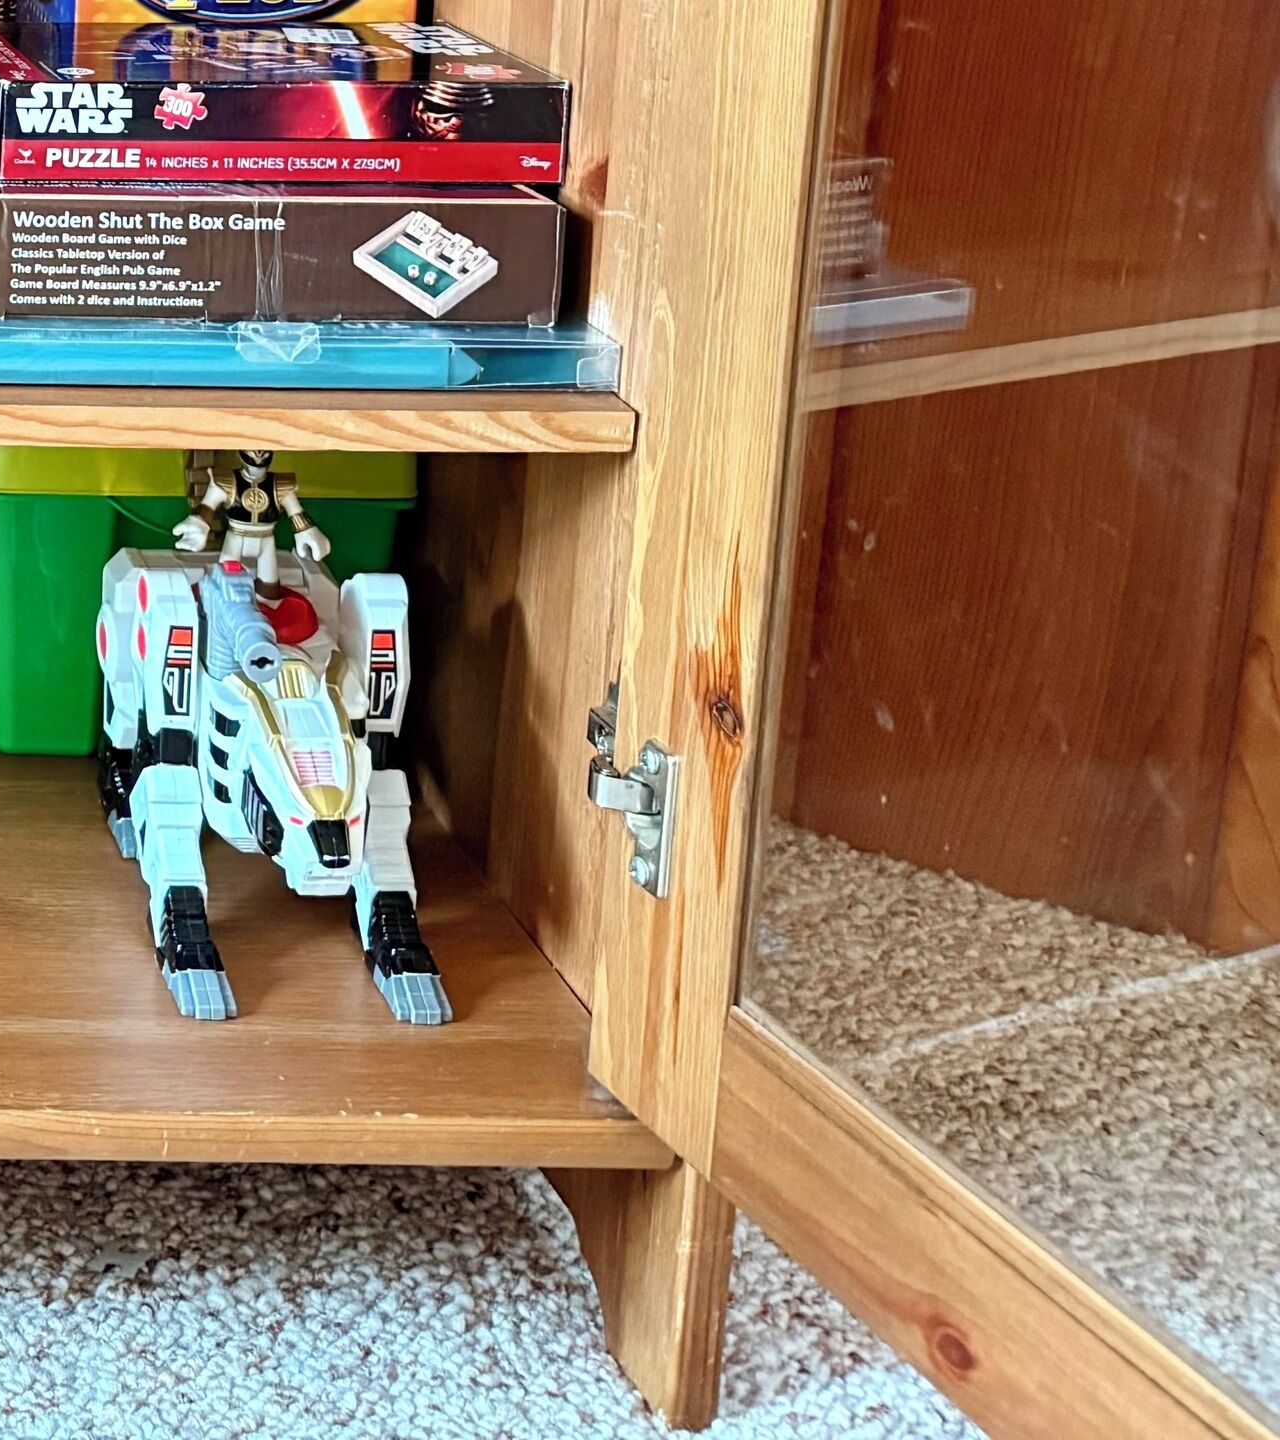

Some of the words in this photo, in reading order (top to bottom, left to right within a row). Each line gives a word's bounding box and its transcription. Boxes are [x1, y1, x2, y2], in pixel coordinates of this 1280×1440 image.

[15, 83, 133, 109] STAR
[164, 95, 193, 117] 300
[15, 108, 133, 134] WARS
[45, 147, 142, 168] PUZZLE
[145, 157, 158, 168] 14
[161, 157, 209, 169] INCHES
[237, 157, 285, 169] INCHES
[288, 156, 339, 171] (35.5CM
[518, 155, 551, 170] Disney
[13, 211, 94, 229] Wooden
[98, 211, 143, 229] Shut
[148, 212, 184, 230] The
[188, 213, 224, 230] Box
[228, 213, 286, 231] Game
[11, 233, 59, 243] Wooden
[62, 233, 95, 244] Board
[98, 234, 132, 245] Game
[134, 234, 160, 245] with
[162, 234, 188, 245] Dice
[11, 248, 54, 259] Classics
[56, 249, 105, 261] Tabletop
[107, 249, 150, 260] Version
[152, 249, 165, 260] of
[10, 263, 32, 274] The
[34, 264, 78, 276] Popular
[80, 264, 120, 276] English
[122, 265, 145, 275] Pub
[147, 265, 181, 276] Game
[10, 279, 43, 290] Game
[45, 279, 79, 290] Board
[81, 280, 137, 291] Measures
[9, 294, 47, 304] Comes
[48, 294, 75, 305] with
[86, 295, 111, 305] dice
[112, 295, 134, 305] and
[136, 296, 203, 307] Instructions
